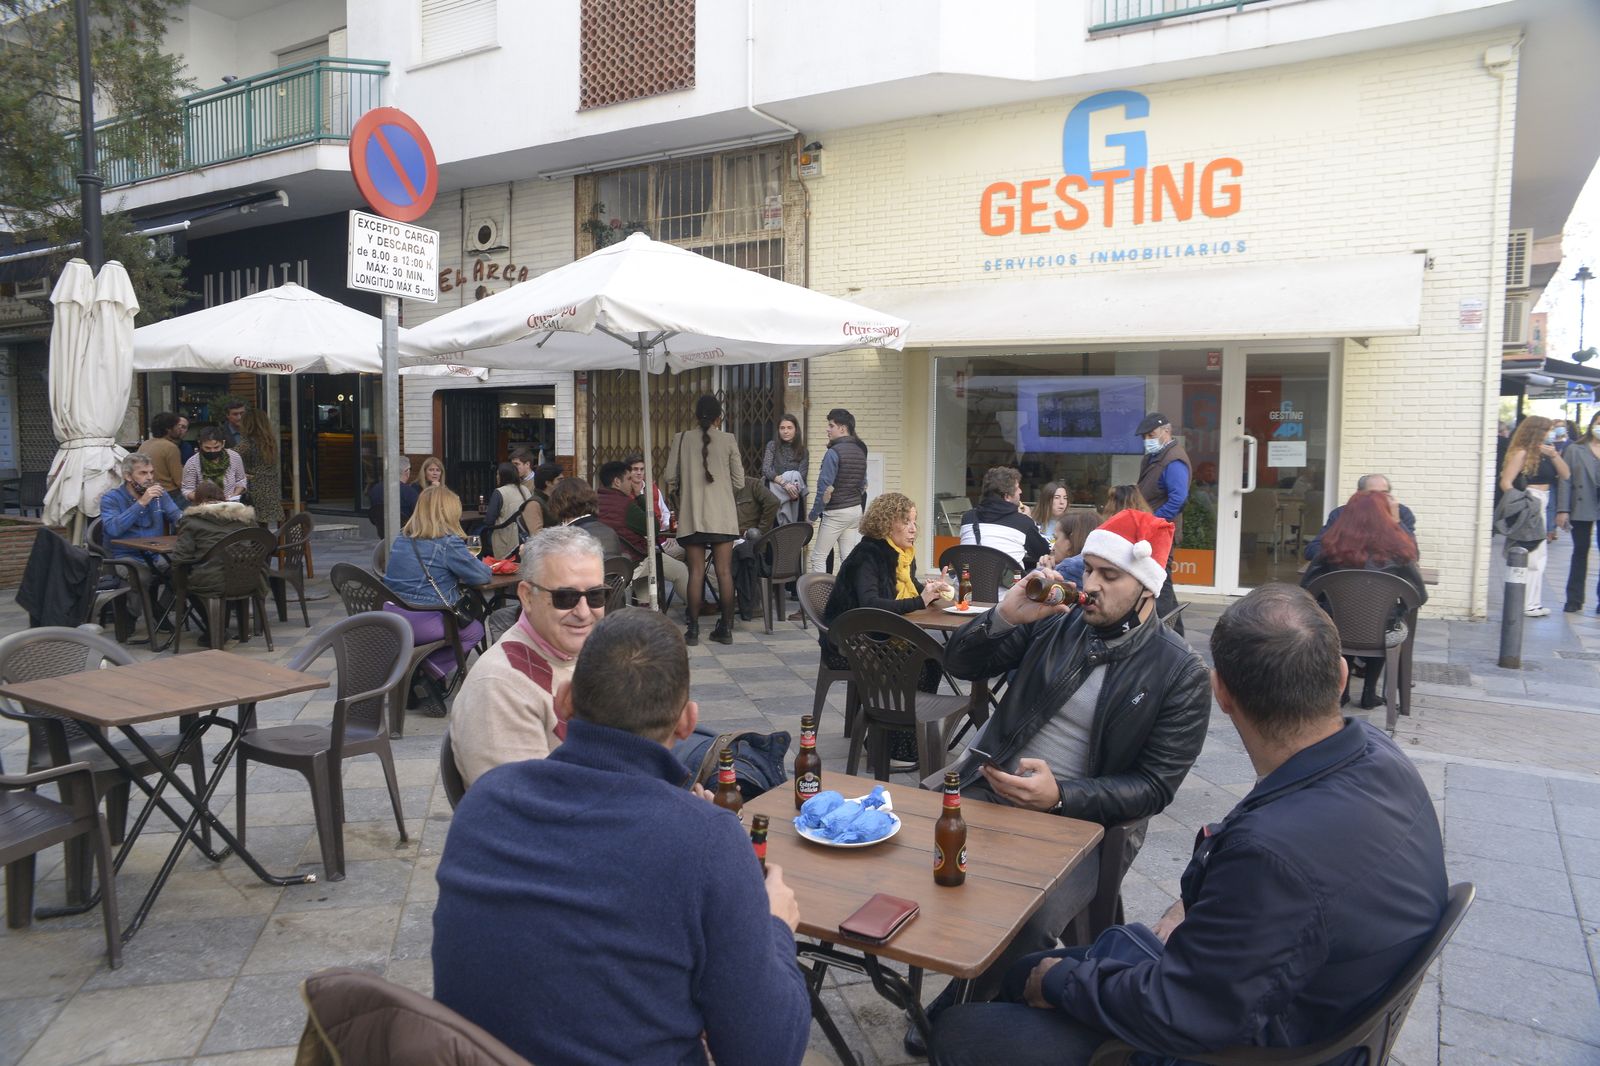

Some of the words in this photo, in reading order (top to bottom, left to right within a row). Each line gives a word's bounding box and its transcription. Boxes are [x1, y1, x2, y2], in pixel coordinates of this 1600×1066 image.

[1062, 89, 1150, 187] G
[979, 157, 1243, 237] GESTING
[358, 218, 400, 236] EXCEPTO
[404, 229, 435, 245] CARGA
[367, 234, 373, 244] Y
[377, 236, 426, 256] DESCARGA
[983, 253, 1078, 272] SERVICIOS
[1089, 240, 1248, 264] INMOBILIARIOS
[357, 246, 369, 257] de
[371, 249, 390, 261] 8.00
[402, 256, 424, 269] 12:00
[355, 273, 394, 288] LONGITUD
[415, 285, 420, 294] 5
[421, 288, 434, 297] mts
[392, 267, 402, 277] 30
[406, 269, 425, 282] MIN.
[439, 268, 468, 292] EL
[473, 258, 529, 282] ARCA
[233, 356, 294, 373] Cruzcampo
[1269, 411, 1304, 420] GESTING
